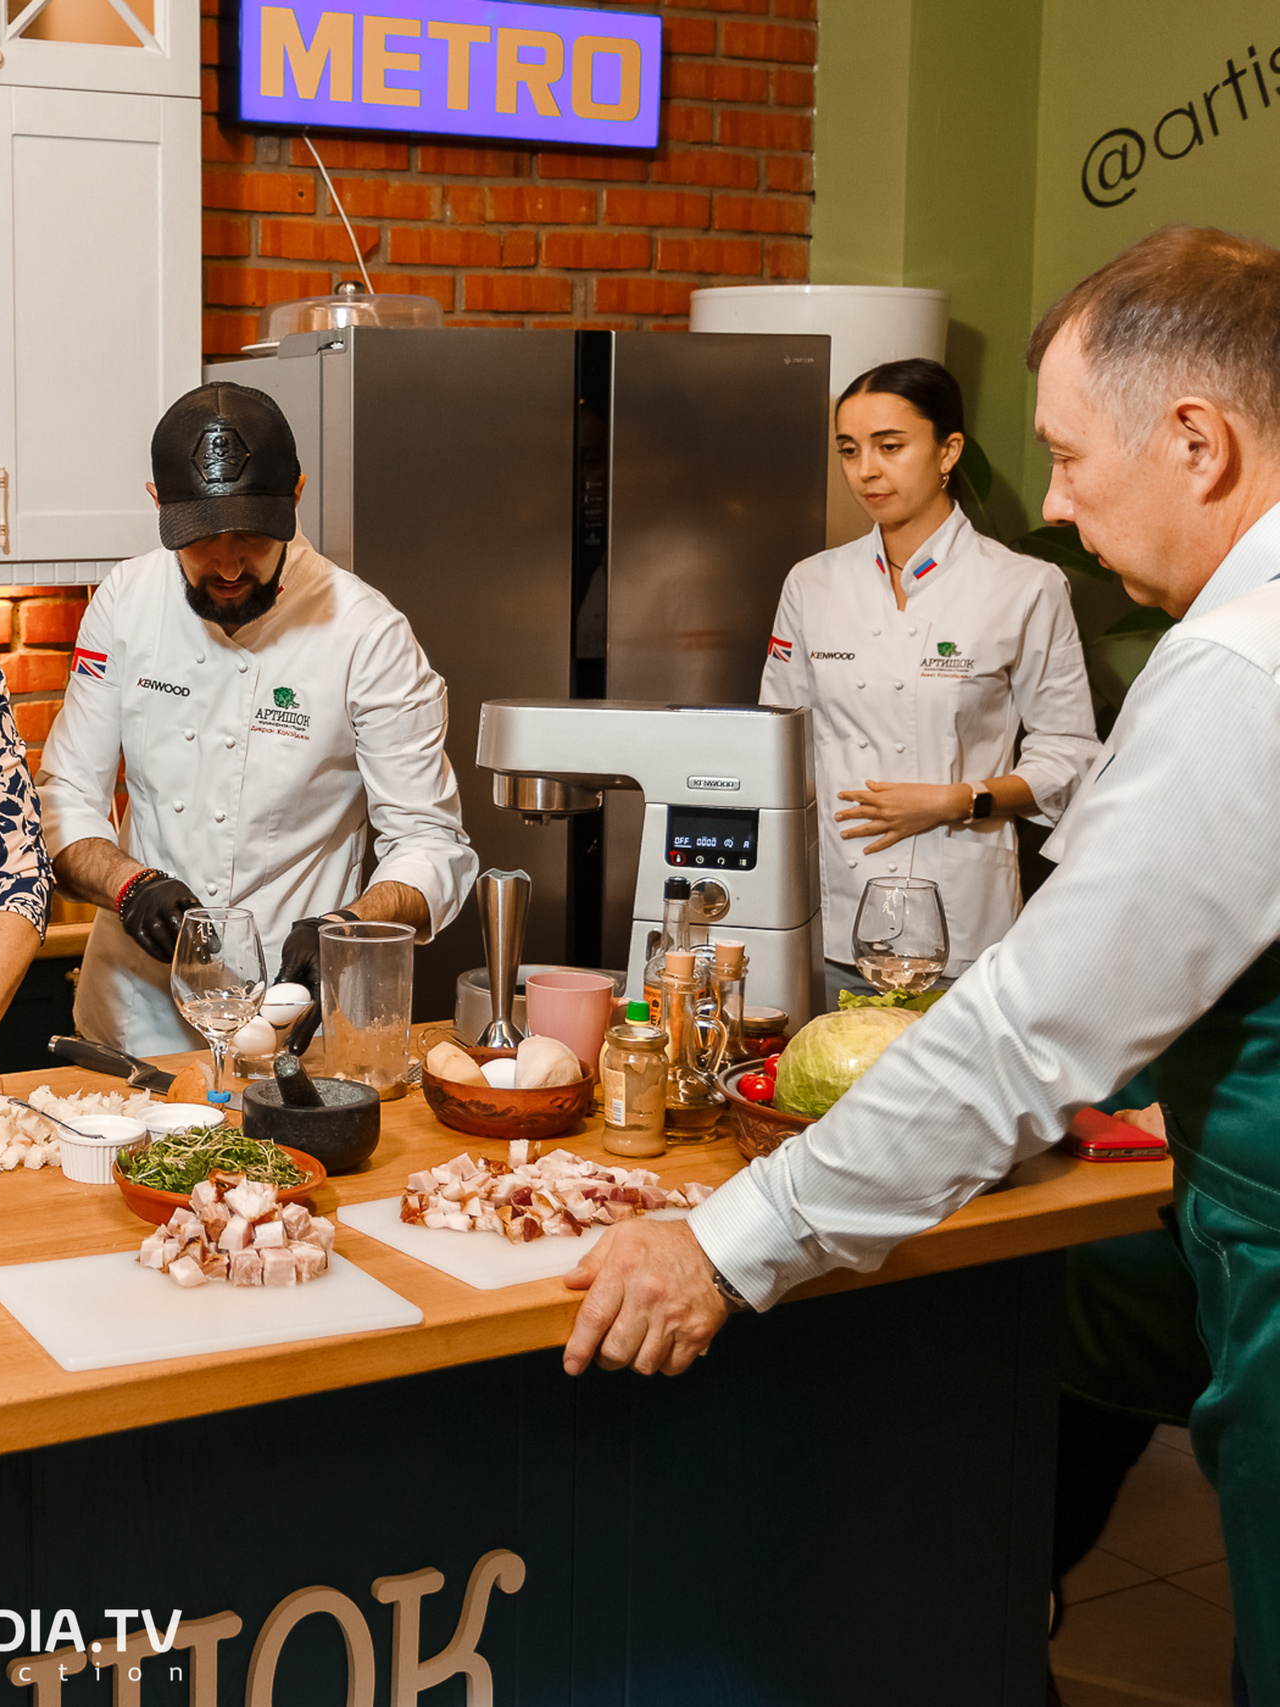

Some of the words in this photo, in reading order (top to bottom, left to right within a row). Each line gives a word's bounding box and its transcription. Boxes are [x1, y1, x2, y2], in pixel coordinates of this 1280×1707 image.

[260, 6, 641, 122] METRO
[811, 651, 855, 660] KENWOOD
[920, 658, 974, 669] АРТИШОК
[137, 678, 190, 697] KENWOOD
[255, 708, 310, 727] АРТИШОК
